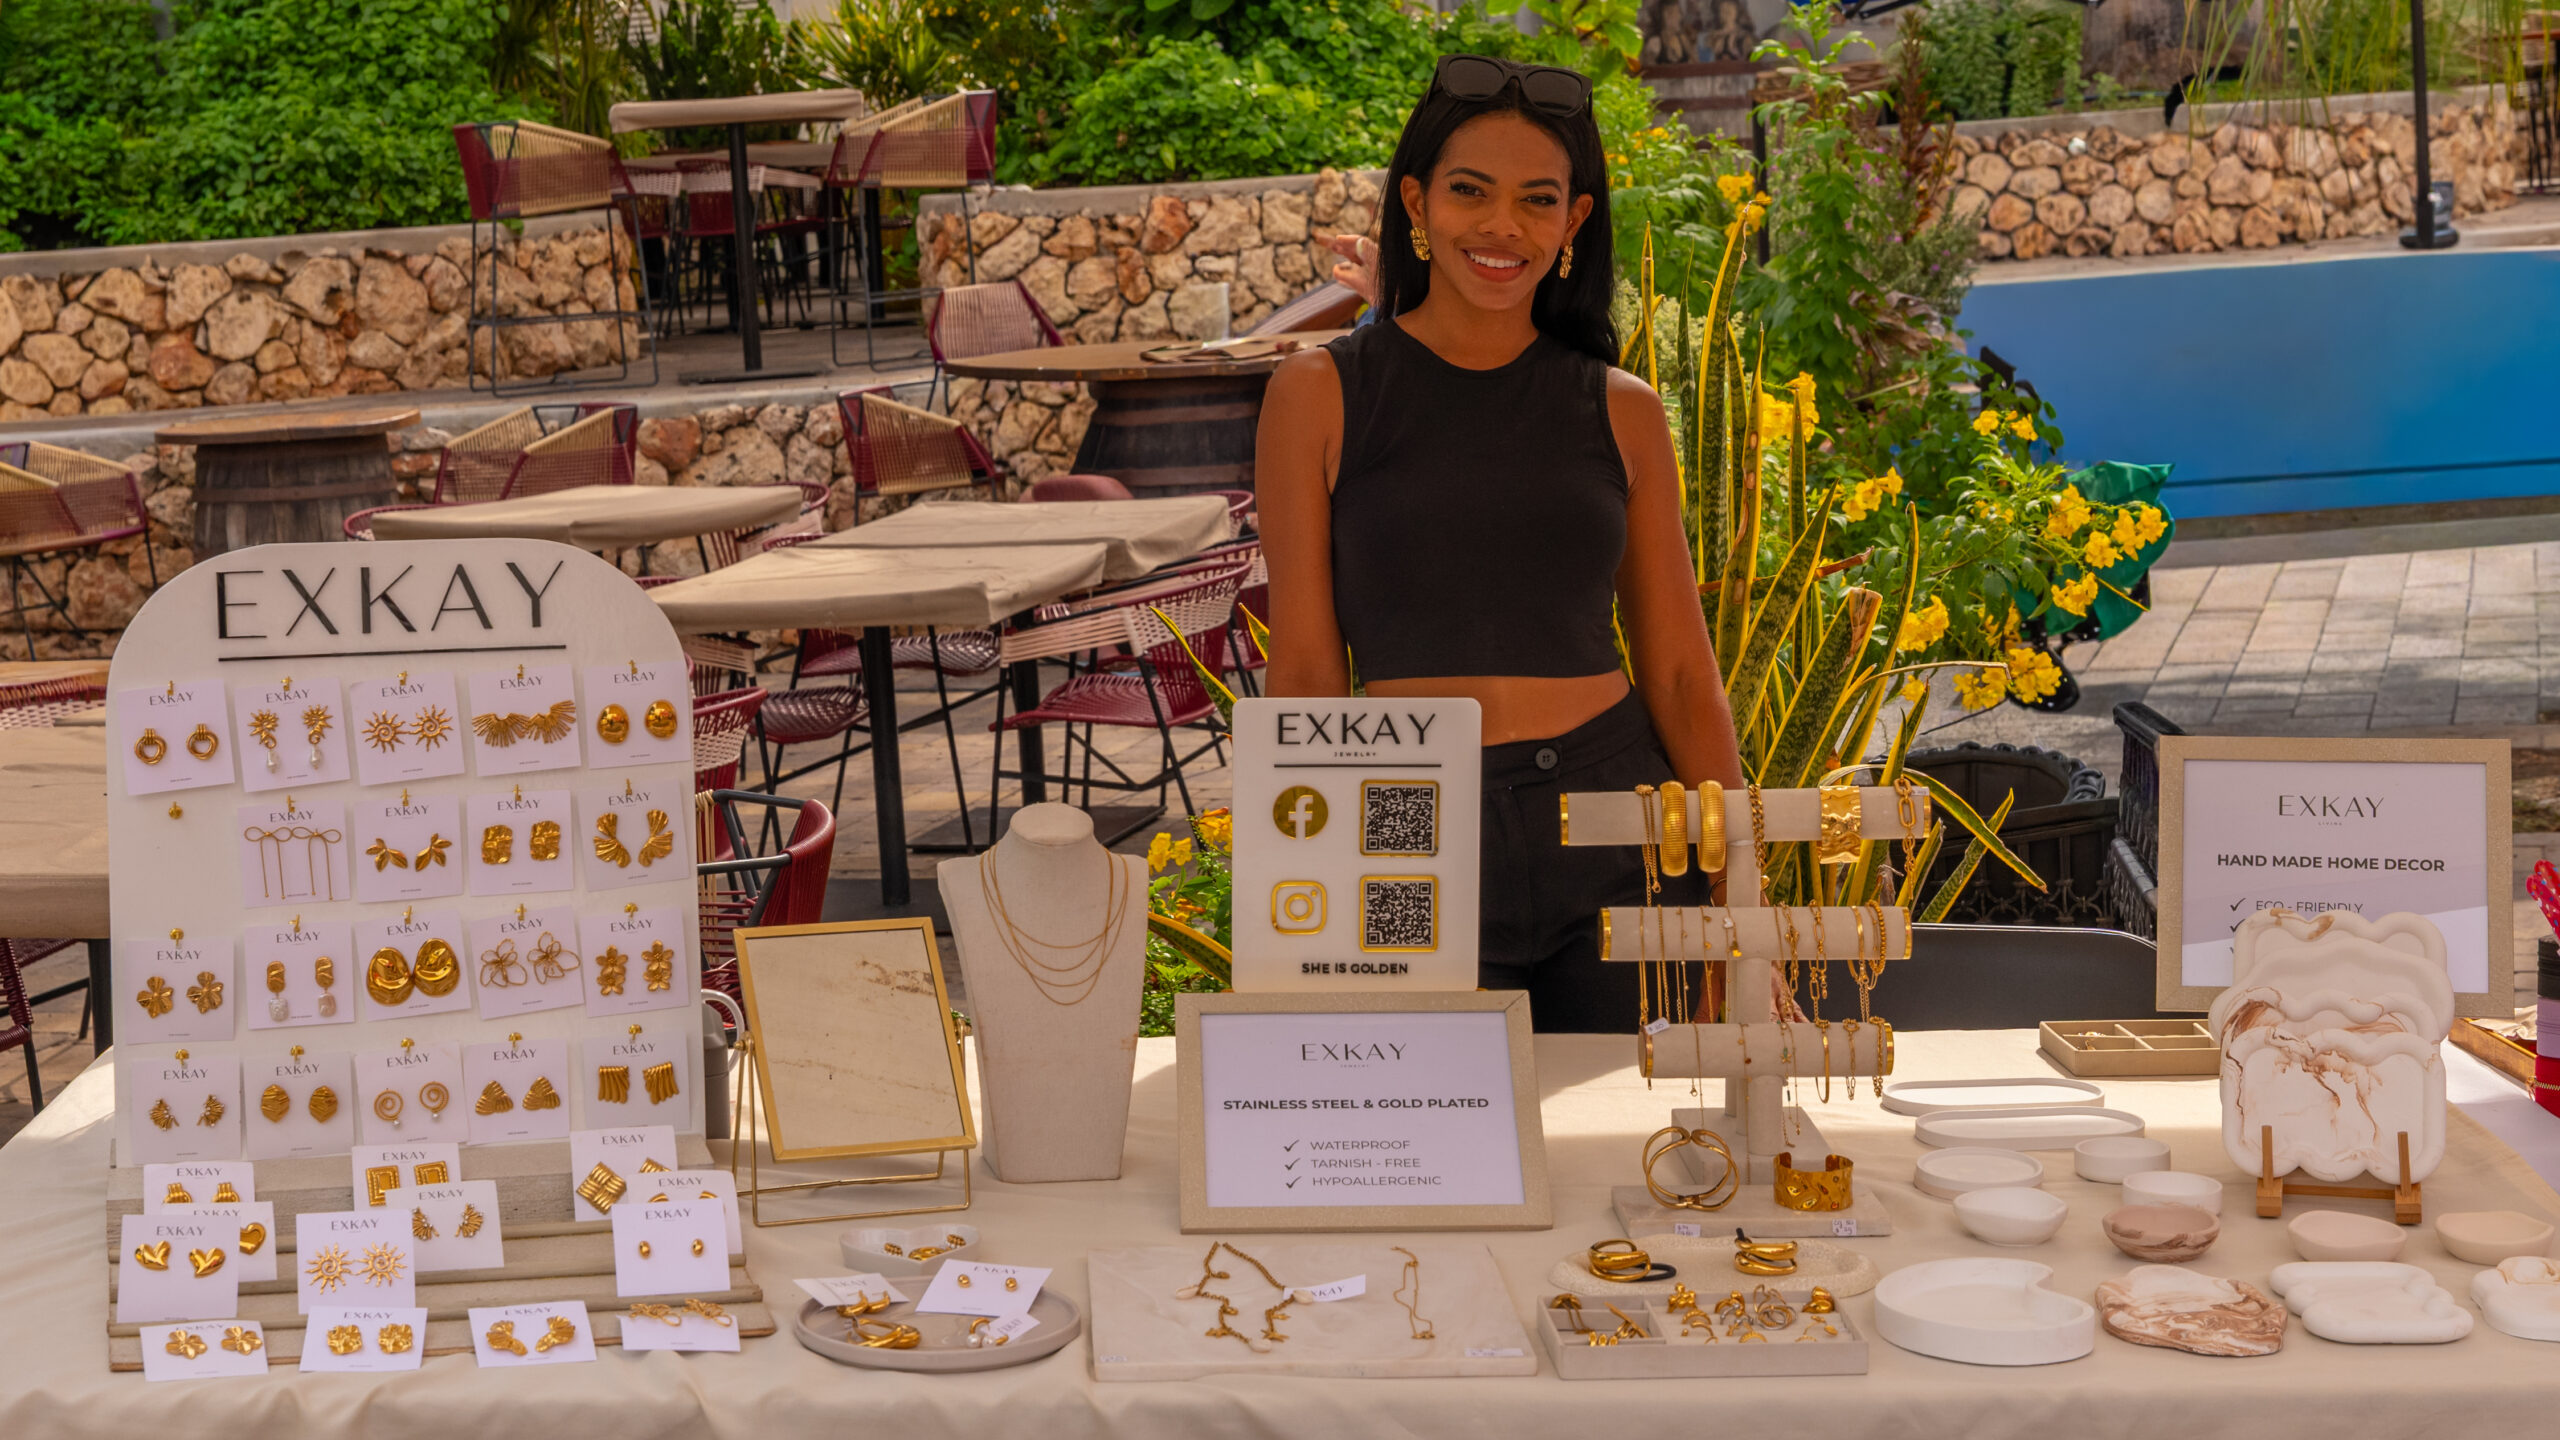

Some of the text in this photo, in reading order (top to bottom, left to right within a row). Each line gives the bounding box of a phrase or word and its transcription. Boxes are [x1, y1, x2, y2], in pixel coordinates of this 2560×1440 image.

[216, 560, 564, 639] EXKAY
[499, 676, 543, 690] EXKAY
[613, 671, 657, 684] EXKAY
[266, 688, 310, 703] EXKAY
[381, 683, 425, 698] EXKAY
[149, 691, 194, 706] EXKAY
[1277, 712, 1436, 745] EXKAY
[608, 791, 651, 806] EXKAY
[385, 805, 429, 817] EXKAY
[497, 799, 541, 812] EXKAY
[2278, 794, 2384, 818] EXKAY
[269, 810, 314, 823] EXKAY
[2217, 854, 2445, 872] HAND MADE HOME DECOR
[2255, 900, 2285, 911] ECO
[2296, 901, 2364, 913] FRIENDLY
[386, 921, 431, 936] EXKAY
[500, 918, 544, 933] EXKAY
[610, 918, 654, 933] EXKAY
[275, 931, 321, 944] EXKAY
[157, 950, 202, 961] EXKAY
[1302, 963, 1408, 974] SHE IS GOLDEN
[493, 1048, 537, 1061] EXKAY
[612, 1043, 657, 1056] EXKAY
[1301, 1043, 1407, 1061] EXKAY
[386, 1053, 430, 1068] EXKAY
[163, 1069, 208, 1080] EXKAY
[275, 1063, 320, 1077] EXKAY
[1223, 1098, 1489, 1110] STAINLESS STEEL & GOLD PLATED
[601, 1133, 646, 1145] EXKAY
[1310, 1140, 1411, 1150] WATERPROOF
[382, 1151, 428, 1161] EXKAY
[1310, 1159, 1372, 1168] TARNISH
[1385, 1158, 1421, 1168] FREE
[176, 1167, 223, 1177] EXKAY
[658, 1176, 704, 1187] EXKAY
[1312, 1176, 1442, 1186] HYPOALLERGENIC
[418, 1188, 464, 1200] EXKAY
[645, 1207, 692, 1220] EXKAY
[156, 1225, 206, 1237] EXKAY
[331, 1218, 380, 1231] EXKAY
[1311, 1285, 1344, 1297] XKAY
